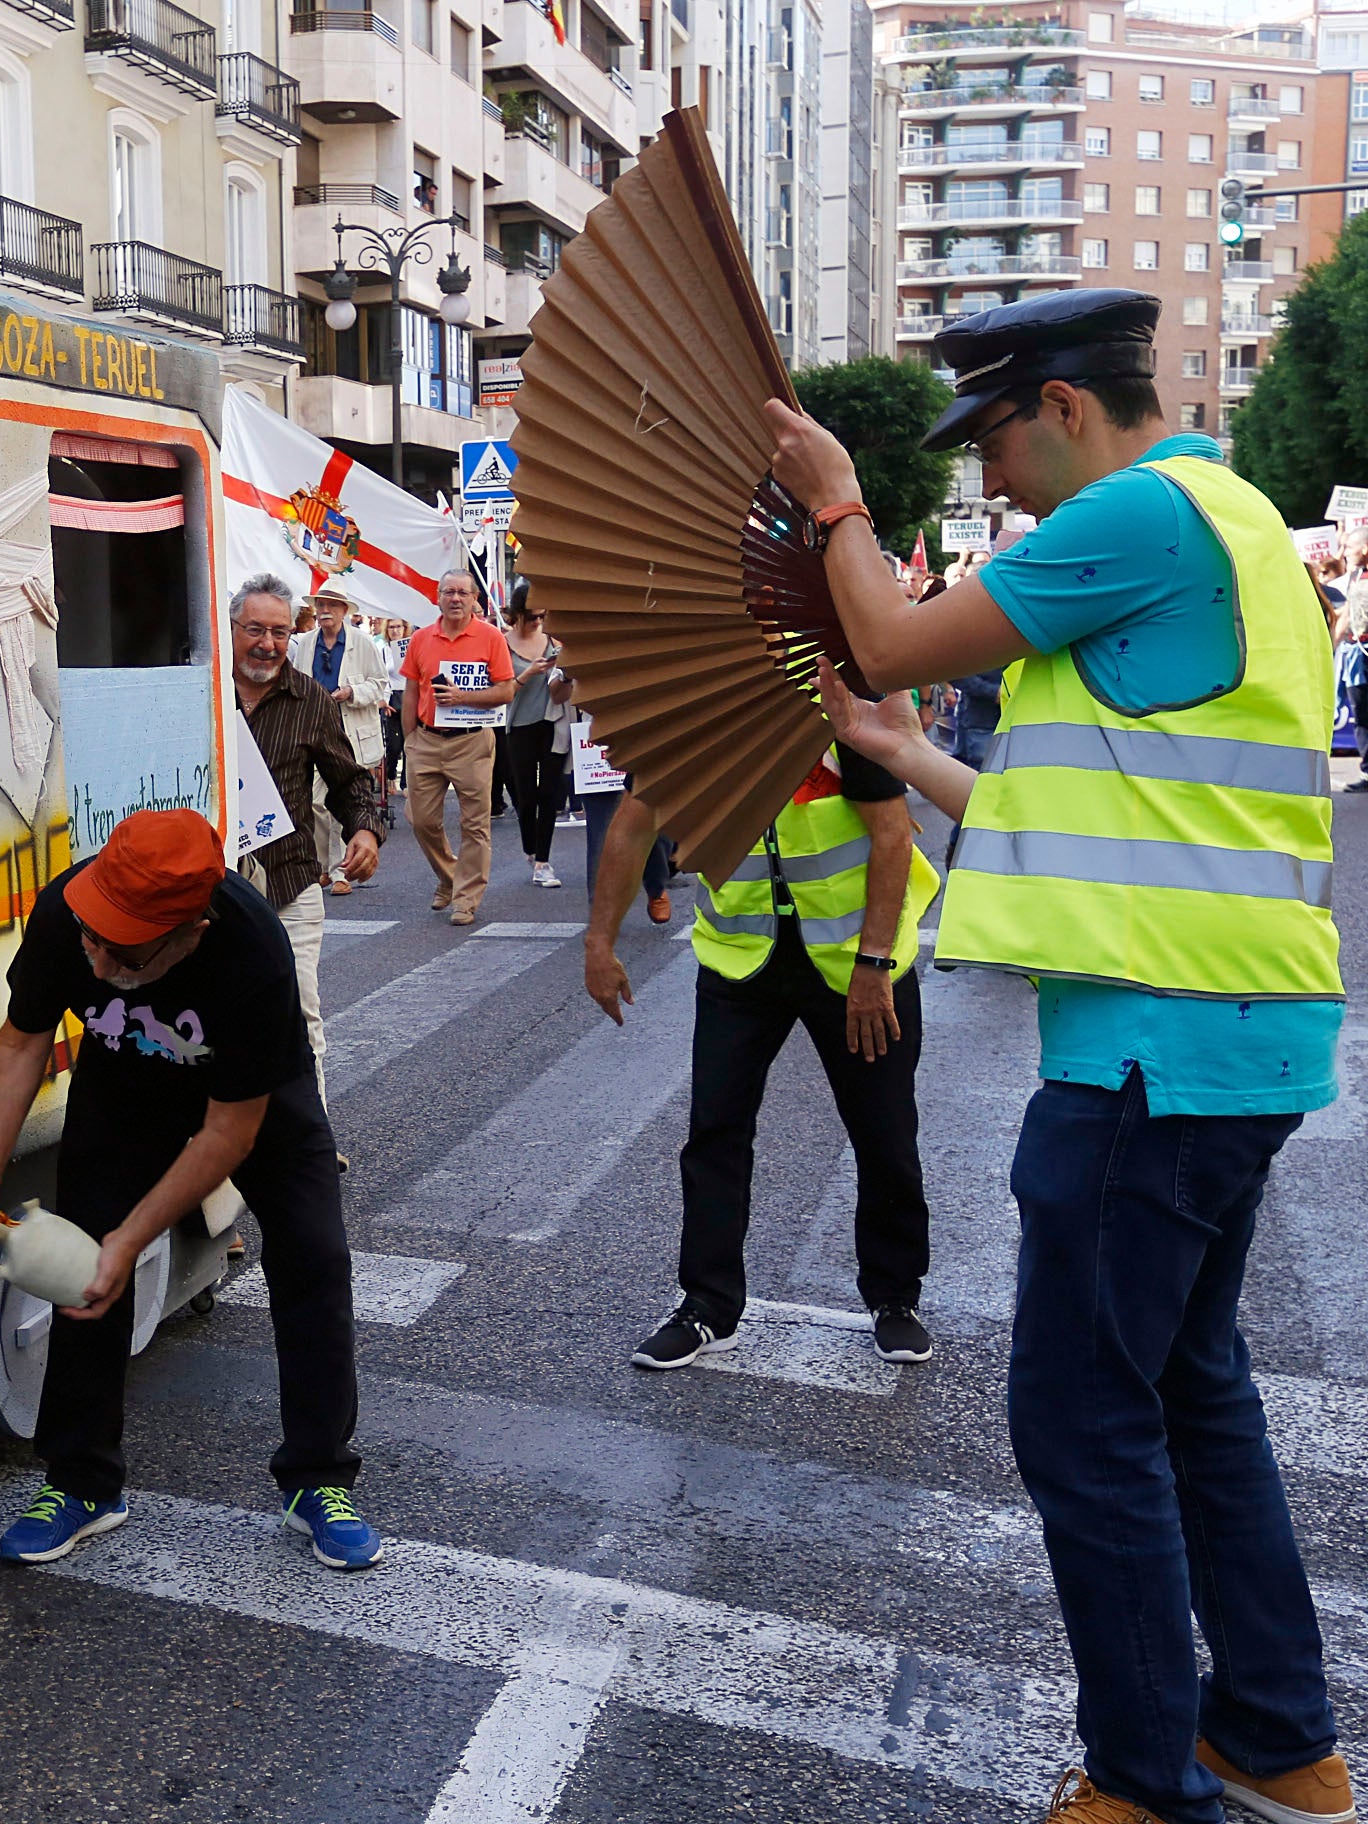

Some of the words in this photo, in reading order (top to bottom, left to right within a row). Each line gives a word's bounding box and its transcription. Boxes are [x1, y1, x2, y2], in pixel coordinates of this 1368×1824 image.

[74, 326, 165, 400] TERUEL
[947, 522, 985, 530] TERUEL
[451, 664, 474, 675] SER
[454, 675, 470, 686] NO
[68, 784, 80, 851] el
[84, 782, 115, 847] tren
